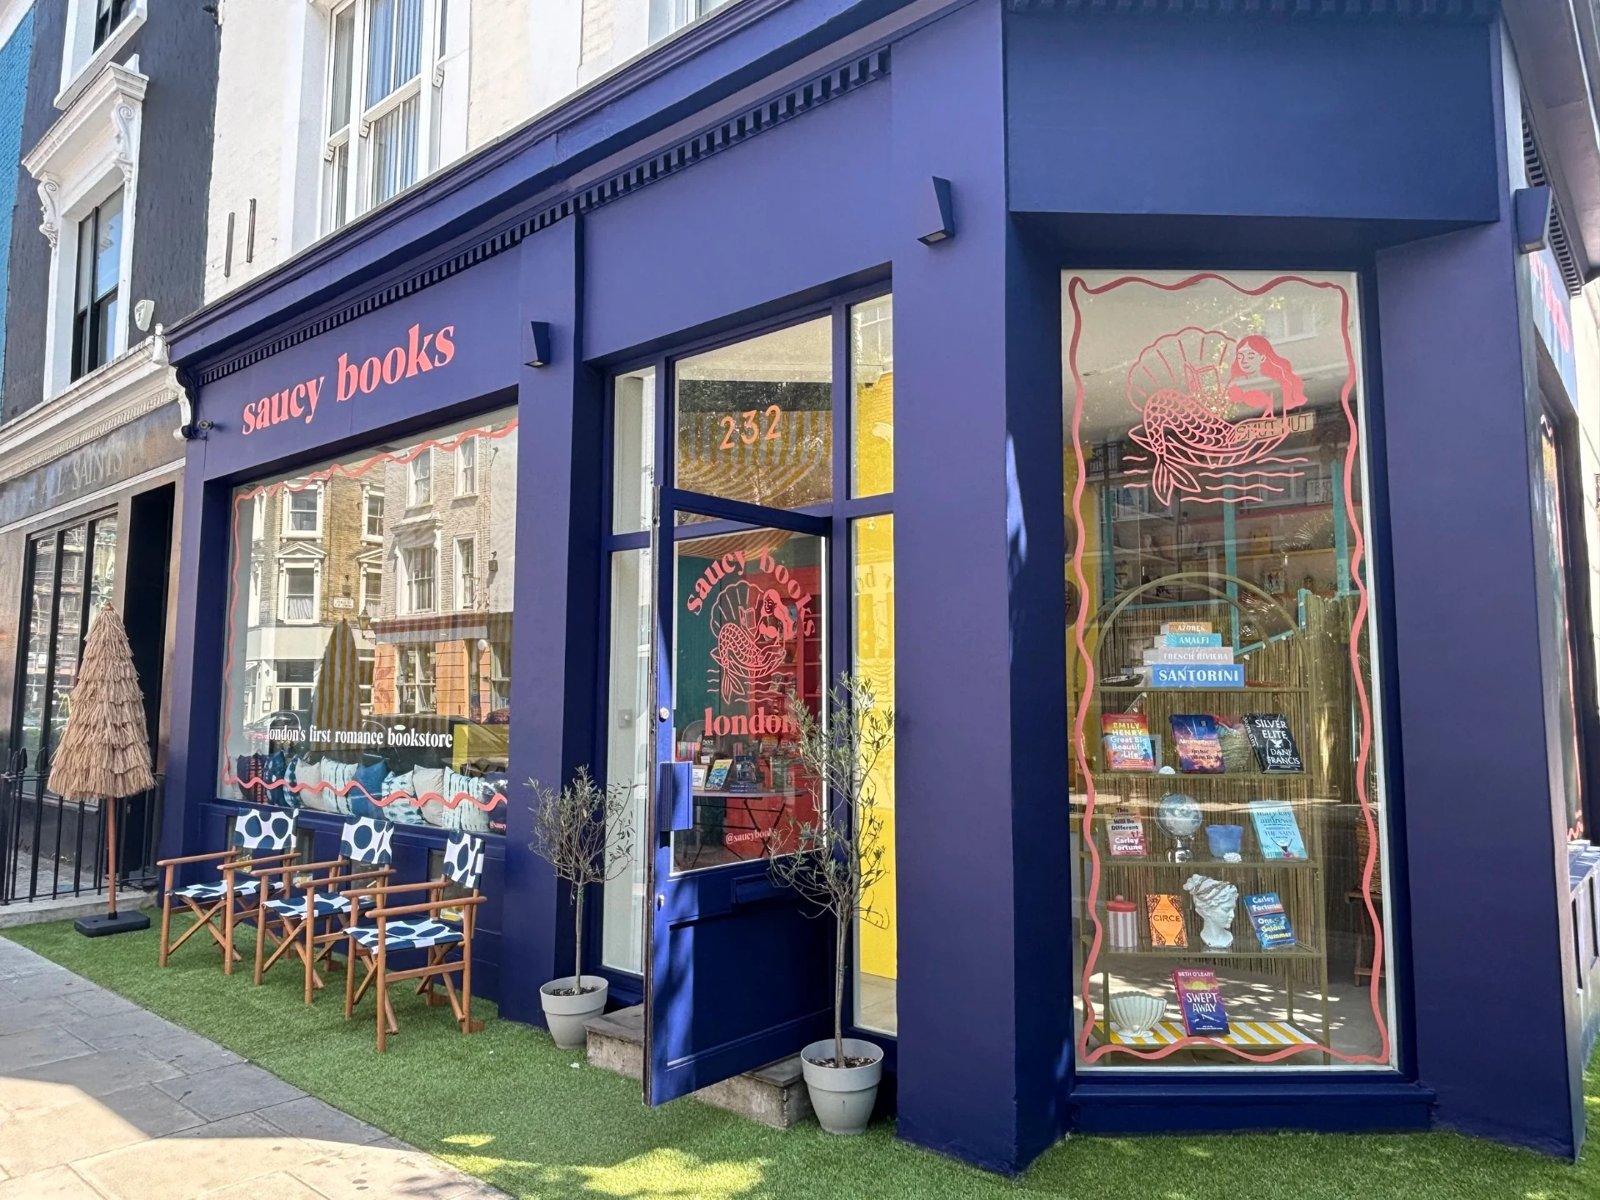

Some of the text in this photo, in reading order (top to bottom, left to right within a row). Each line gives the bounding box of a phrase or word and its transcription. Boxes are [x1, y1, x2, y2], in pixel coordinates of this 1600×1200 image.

[242, 323, 455, 435] saucy books
[719, 404, 782, 450] 232
[687, 544, 817, 637] saucy books
[1179, 636, 1210, 645] AMALFI
[1158, 669, 1239, 682] SANTORINI
[704, 706, 798, 737] london
[1255, 719, 1288, 729] SILVER
[309, 725, 331, 743] first
[335, 731, 384, 745] romance
[387, 727, 453, 748] bookstore
[1111, 729, 1144, 737] HENRY
[1262, 730, 1288, 739] ELITE
[1267, 756, 1300, 765] FRANCIS
[1114, 837, 1139, 845] Carley
[1252, 895, 1275, 904] Carley
[1252, 903, 1283, 912] Fortune
[1153, 914, 1181, 922] CIRCE
[1185, 992, 1218, 1003] SWEPT
[1192, 1003, 1217, 1013] AWAY
